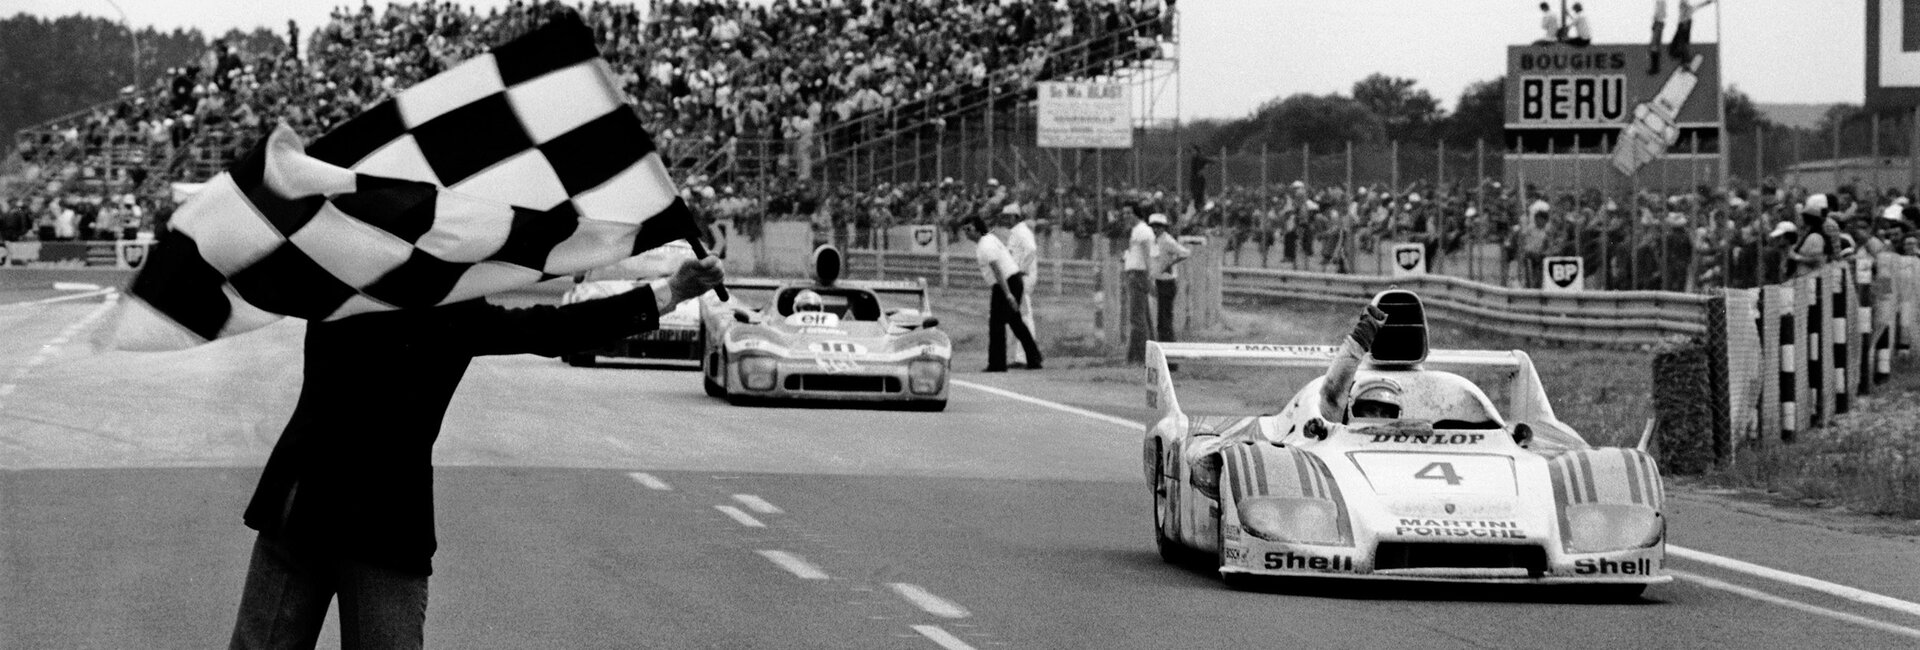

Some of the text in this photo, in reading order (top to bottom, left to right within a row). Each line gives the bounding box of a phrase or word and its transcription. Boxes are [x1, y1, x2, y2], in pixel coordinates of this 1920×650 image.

[1520, 53, 1625, 70] BOUGIES
[1523, 78, 1623, 120] BERU
[1399, 251, 1420, 265] BP
[1552, 263, 1578, 282] BP
[802, 314, 826, 325] elf
[1370, 433, 1485, 445] DUNLOP
[1414, 462, 1463, 485] 4
[1399, 518, 1517, 528] MARTINI
[1395, 526, 1527, 539] PORSCHE
[1264, 551, 1353, 571] Shell
[1574, 557, 1651, 576] Shell
